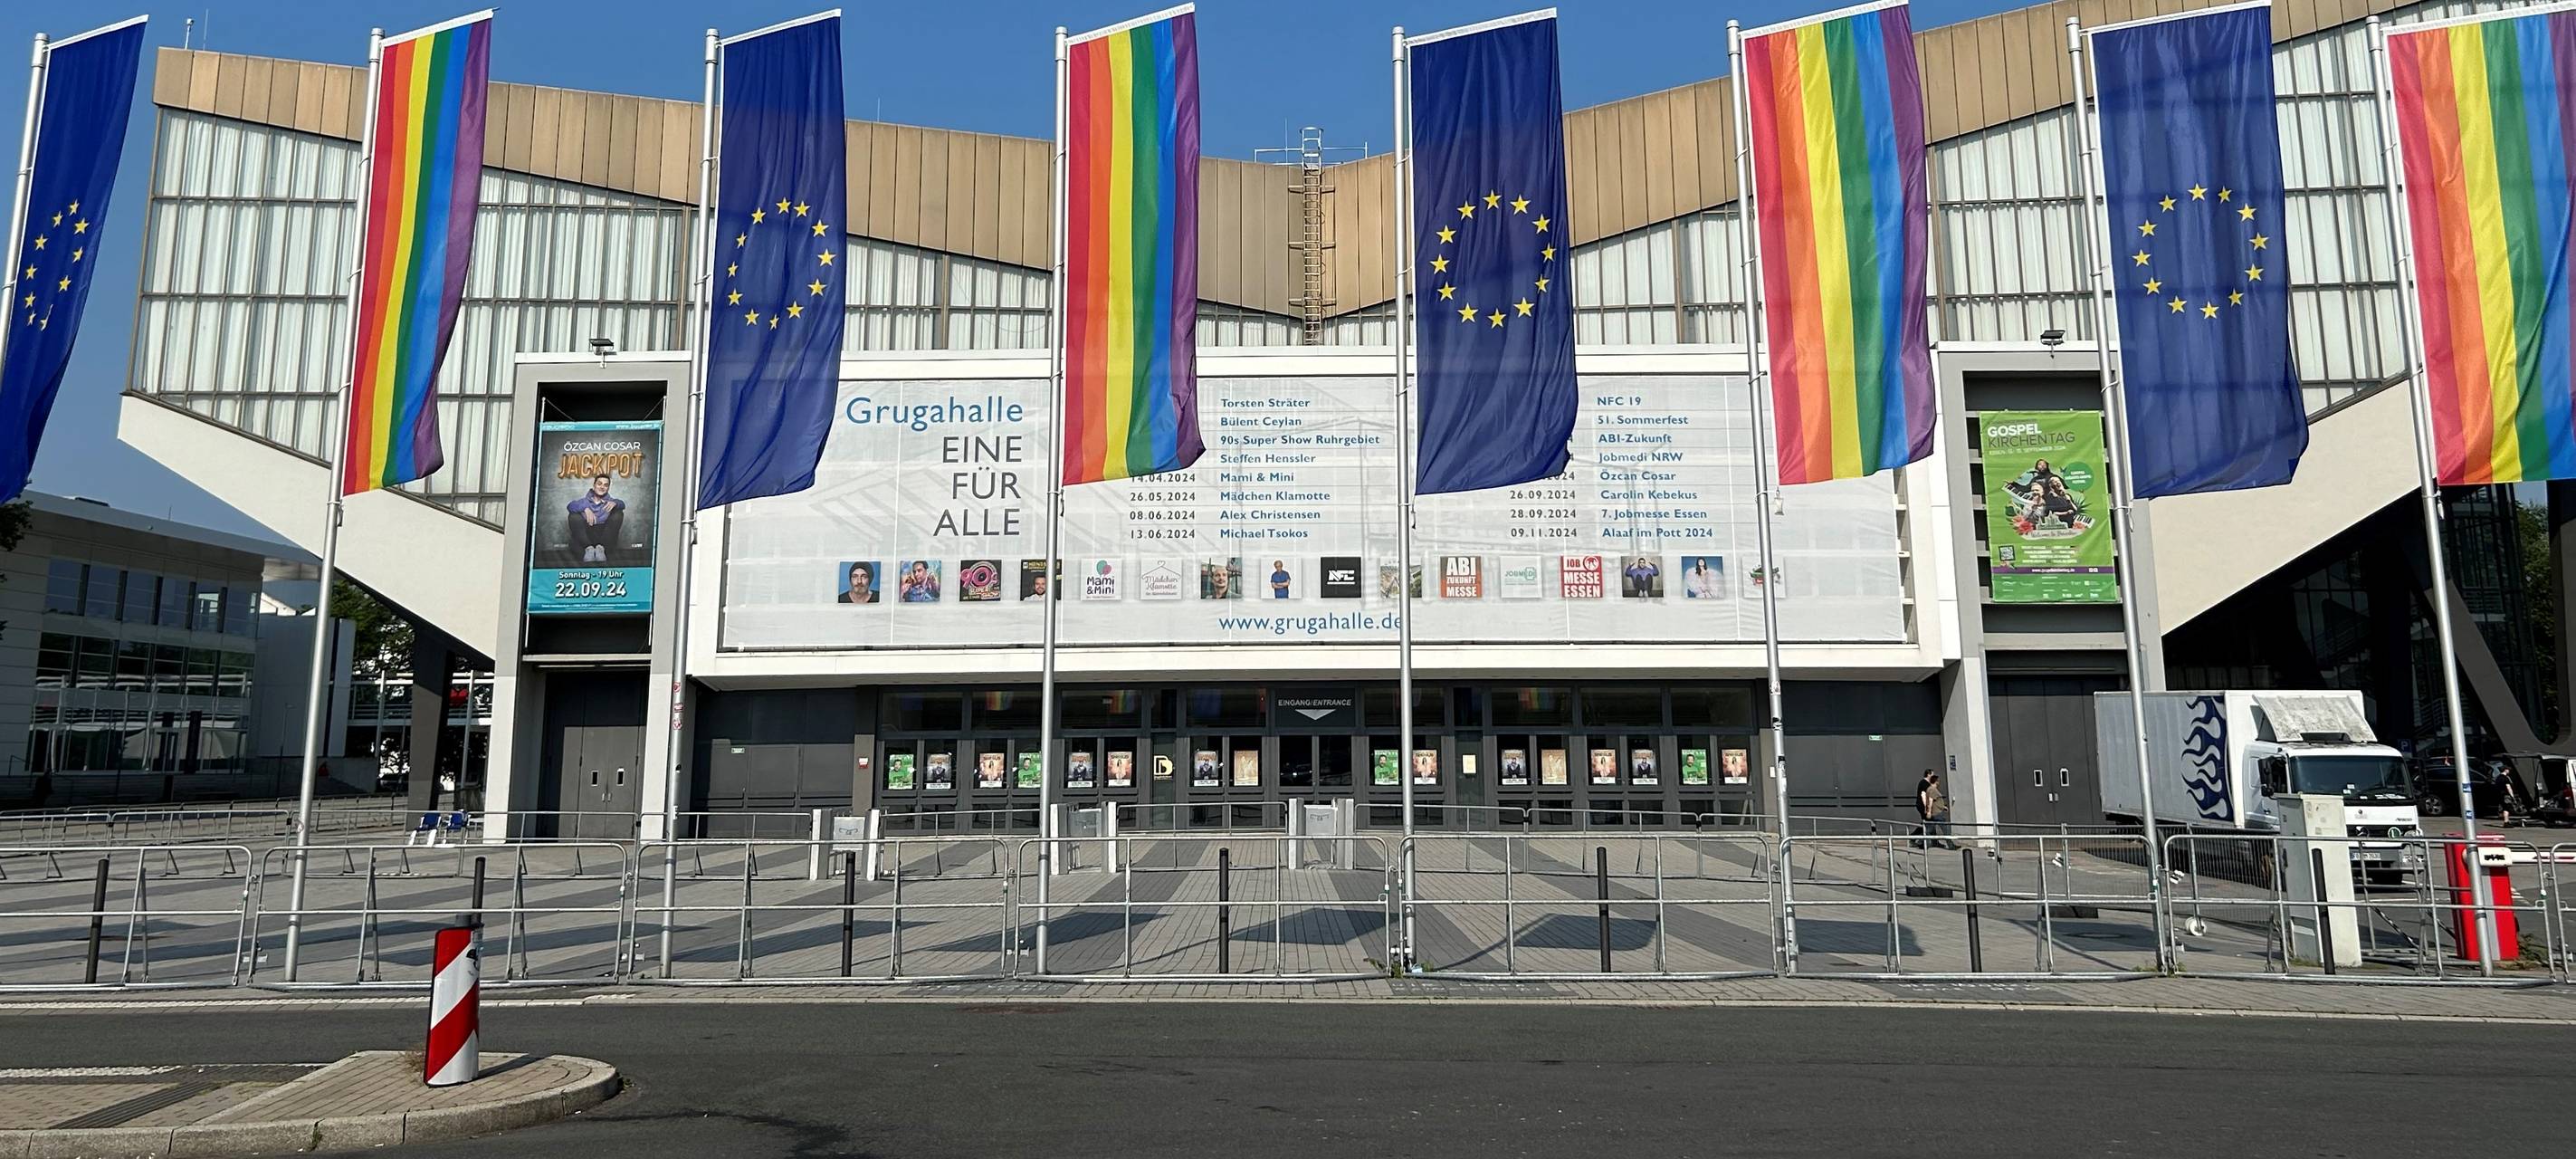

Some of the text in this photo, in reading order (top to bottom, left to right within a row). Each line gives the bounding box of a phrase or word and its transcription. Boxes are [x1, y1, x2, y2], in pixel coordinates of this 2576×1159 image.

[1221, 398, 1310, 408] Torsten Sträter
[1597, 397, 1641, 406] NFC 19
[846, 396, 1023, 431] Grugahalle
[1220, 417, 1302, 428] Bülent Ceylan
[1598, 416, 1688, 425] 51. Sommerfest
[1987, 423, 2042, 437] GOSPEL
[1220, 435, 1379, 446] 90s Super Show Ruhrgebiet
[1598, 434, 1672, 444] ABI-Zukunft
[1988, 431, 2075, 448] KIRCHENTAG
[563, 441, 641, 452] ÖZCAN COSAR
[942, 436, 1022, 463] EINE
[1220, 454, 1316, 464] Steffen Henssler
[1599, 453, 1684, 463] Jobmedi NRW
[558, 453, 644, 479] JACKPOT
[1220, 473, 1253, 483] Mami
[1256, 473, 1266, 483] &
[1270, 473, 1294, 483] Mini
[1599, 469, 1676, 481] Özcan Cosar
[953, 466, 1021, 499] FÜR
[1130, 491, 1331, 502] 26.05.2024 Mädchen Klamotte
[1510, 490, 1697, 500] 26.09.2024 Carolin Kebekus
[1130, 510, 1321, 521] 08.06.2024 Alex Christensen
[1510, 509, 1707, 521] 28.09.2024 7. Jobmesse Essen
[933, 509, 1020, 536] ALLE
[1131, 528, 1309, 540] 13.06.2024 Michael Tsokos
[1511, 528, 1713, 538] 09.11.2024 Alaaf im Pott 2024
[1446, 557, 1476, 576] ABI
[558, 571, 590, 580] Sonntag
[609, 570, 625, 579] Uhr
[1086, 575, 1115, 586] Mami
[1329, 570, 1355, 581] NFC
[1563, 572, 1600, 585] MESSE
[555, 581, 626, 597] 22.09.24
[1086, 586, 1115, 595] &Mini
[1446, 587, 1477, 598] MESSE
[1564, 586, 1600, 598] ESSEN
[1219, 611, 1401, 635] www.grugahalle.de
